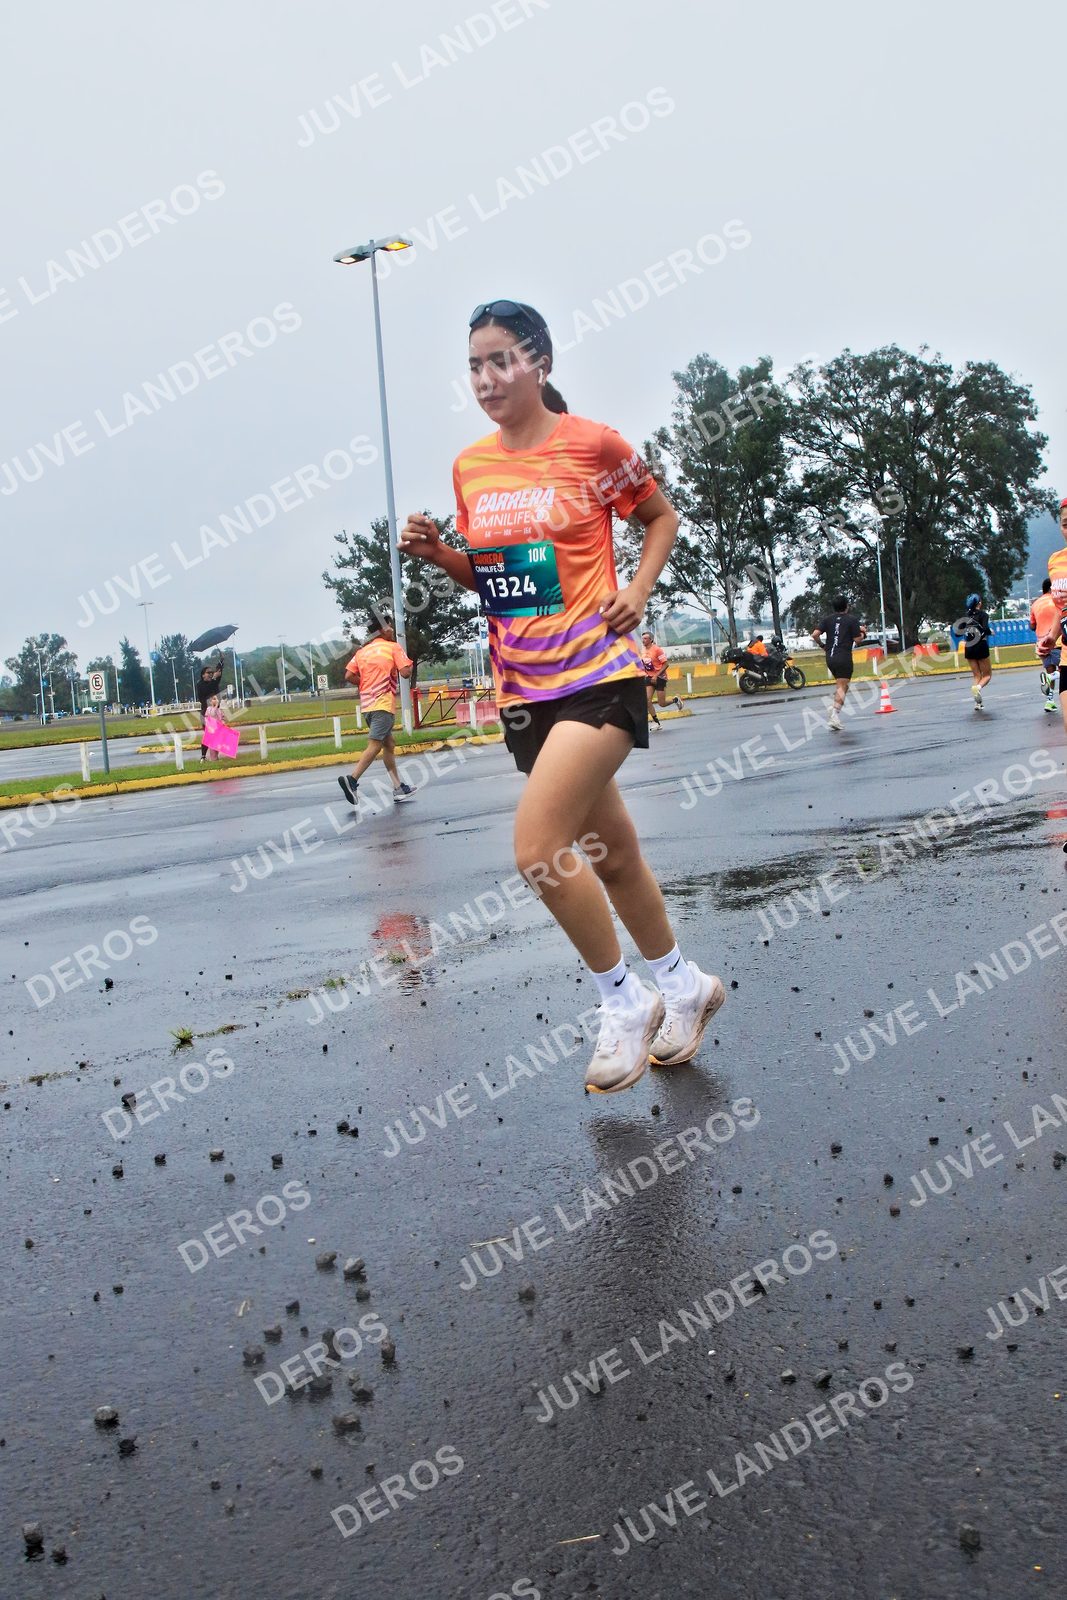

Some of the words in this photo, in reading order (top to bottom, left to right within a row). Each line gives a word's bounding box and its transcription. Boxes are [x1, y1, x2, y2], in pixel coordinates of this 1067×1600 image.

[475, 486, 555, 514] CARRERA
[472, 552, 504, 564] CARRERA
[528, 546, 547, 563] 10K
[486, 575, 537, 597] 1324
